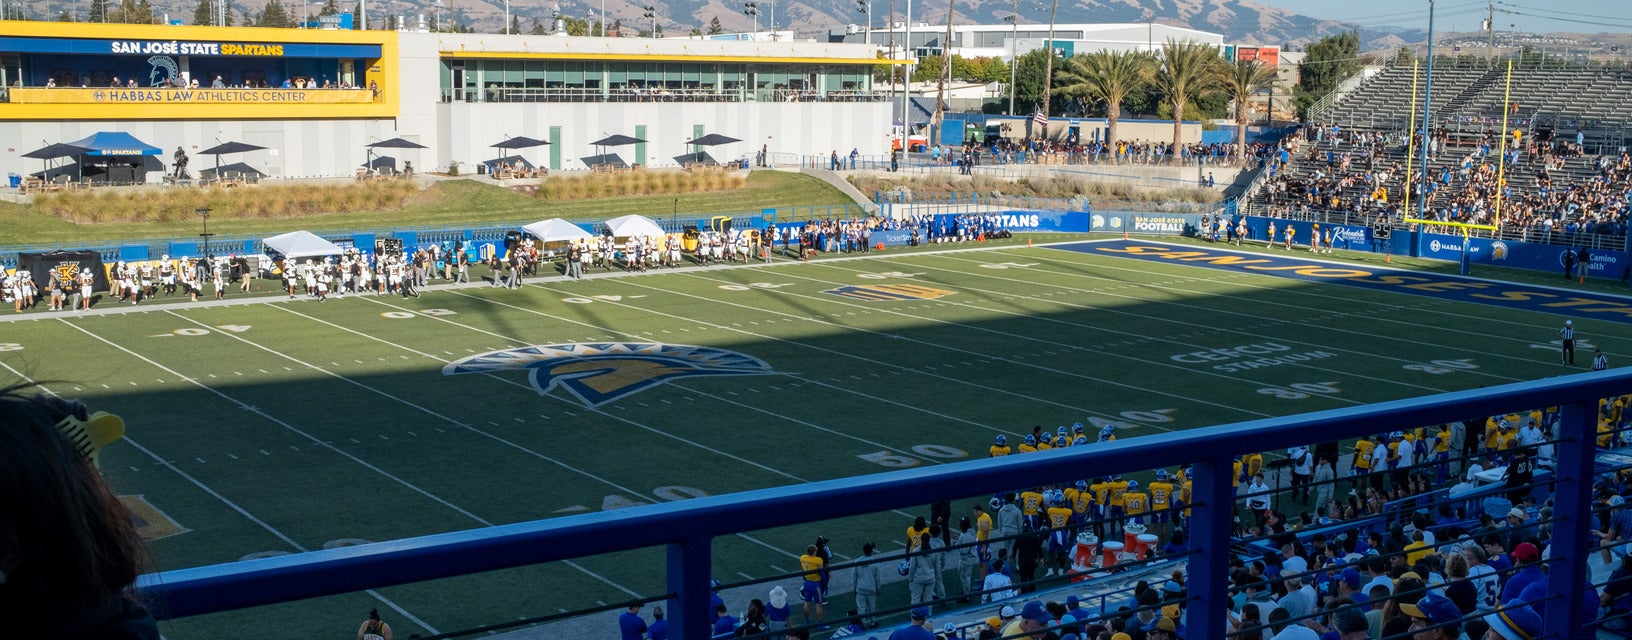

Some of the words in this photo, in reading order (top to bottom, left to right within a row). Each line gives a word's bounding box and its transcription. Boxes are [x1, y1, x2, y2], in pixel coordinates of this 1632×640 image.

[112, 42, 138, 54] SAN
[143, 40, 178, 54] JOSÉ
[180, 43, 219, 55] STATE
[221, 44, 284, 56] SPARTANS
[110, 91, 162, 101] HABBAS
[166, 91, 194, 101] LAW
[197, 92, 259, 102] ATHLETICS
[262, 92, 306, 102] CENTER
[1135, 222, 1184, 232] FOOTBALL
[1374, 224, 1389, 238] 25
[1590, 253, 1617, 264] Camino
[1096, 246, 1273, 265] SAN
[1243, 265, 1498, 292] JOSE
[1170, 342, 1291, 363] CEFCU
[1213, 351, 1339, 373] STADIUM
[1256, 382, 1341, 400] 30
[856, 444, 970, 468] 50
